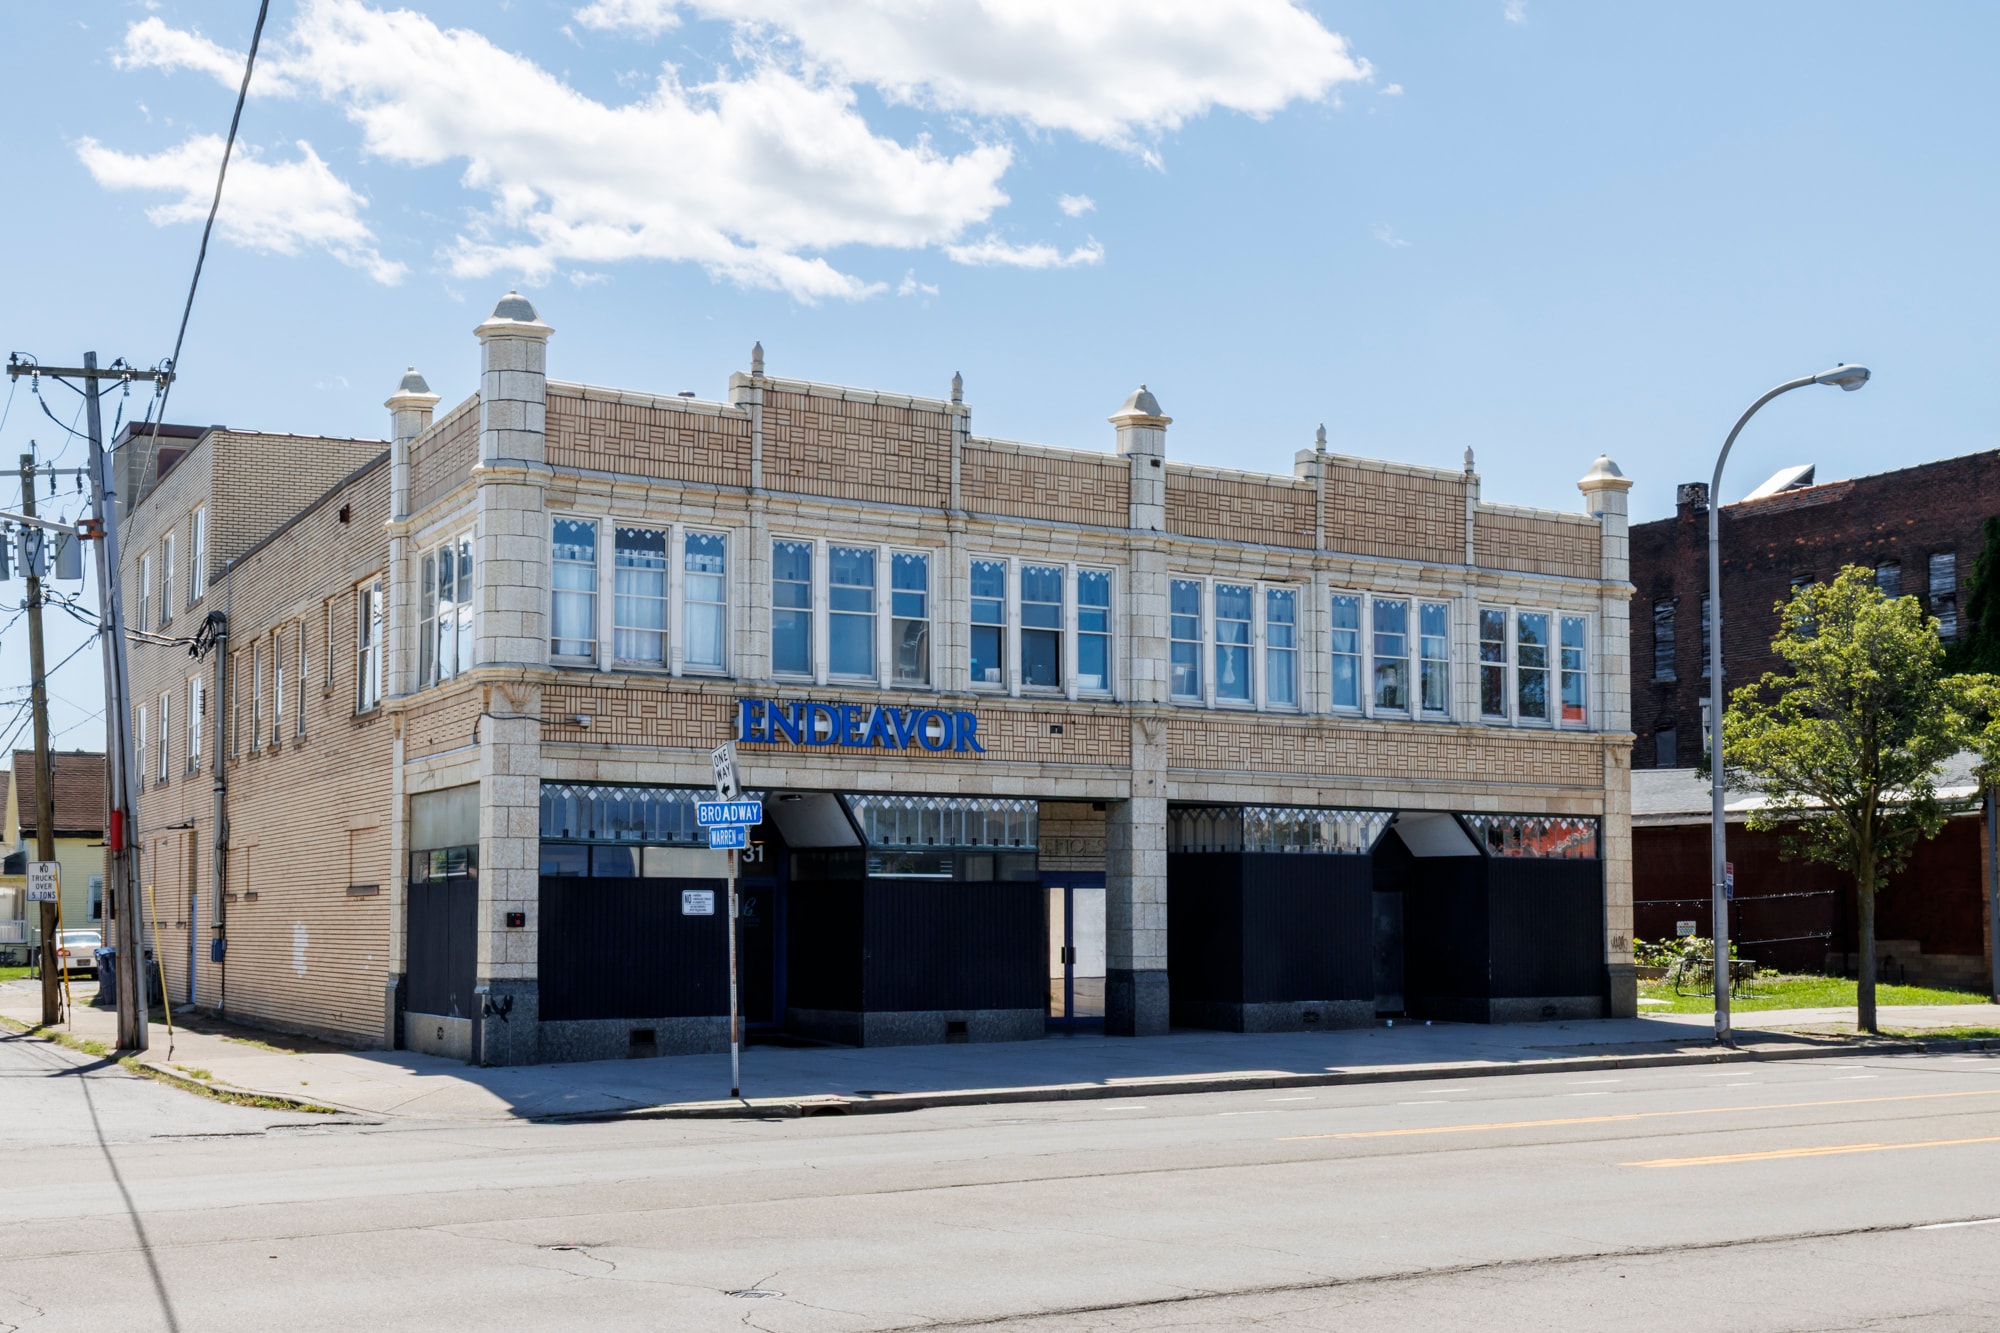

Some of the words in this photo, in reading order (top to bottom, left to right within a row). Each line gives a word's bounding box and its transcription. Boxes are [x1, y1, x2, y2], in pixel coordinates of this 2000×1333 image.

[738, 699, 986, 753] ENDEAVOR
[713, 748, 728, 768] ONE
[716, 763, 732, 782] WAY
[700, 805, 758, 822] BROADWAY
[711, 830, 737, 846] WARREN
[40, 865, 48, 873] NO
[32, 891, 36, 899] 5
[40, 891, 56, 899] TONS
[684, 894, 692, 904] NO
